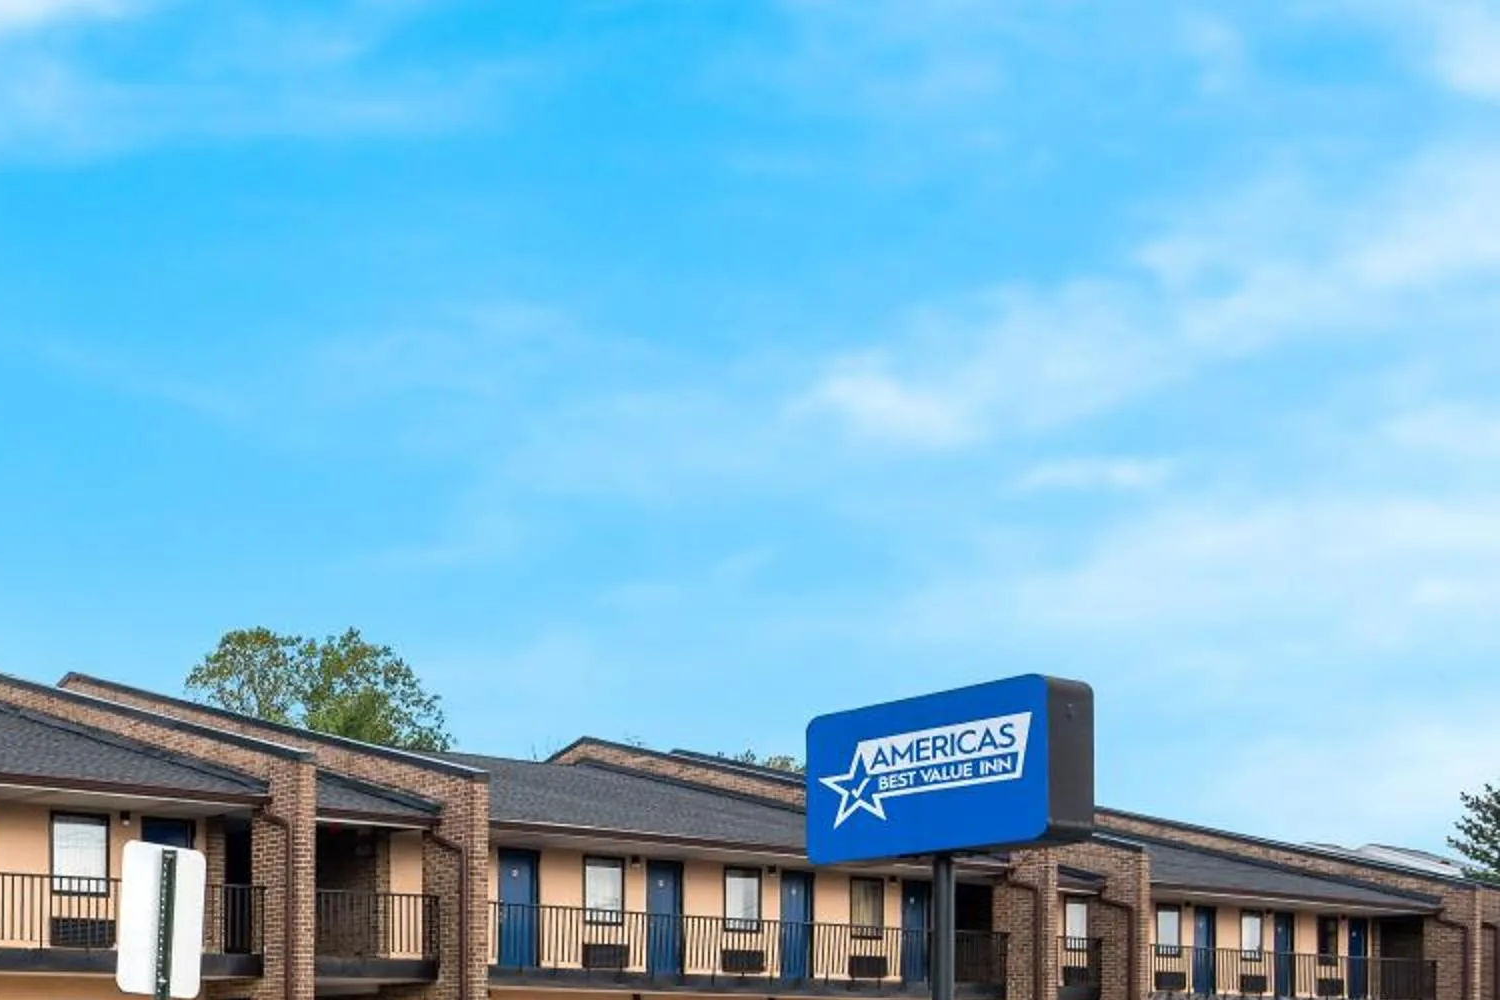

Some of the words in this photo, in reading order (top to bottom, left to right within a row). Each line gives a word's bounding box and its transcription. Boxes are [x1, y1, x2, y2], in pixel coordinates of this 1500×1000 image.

[870, 723, 1014, 769] AMERICAS
[878, 772, 916, 790] BEST
[918, 762, 972, 781] VALUE
[979, 757, 1011, 774] INN
